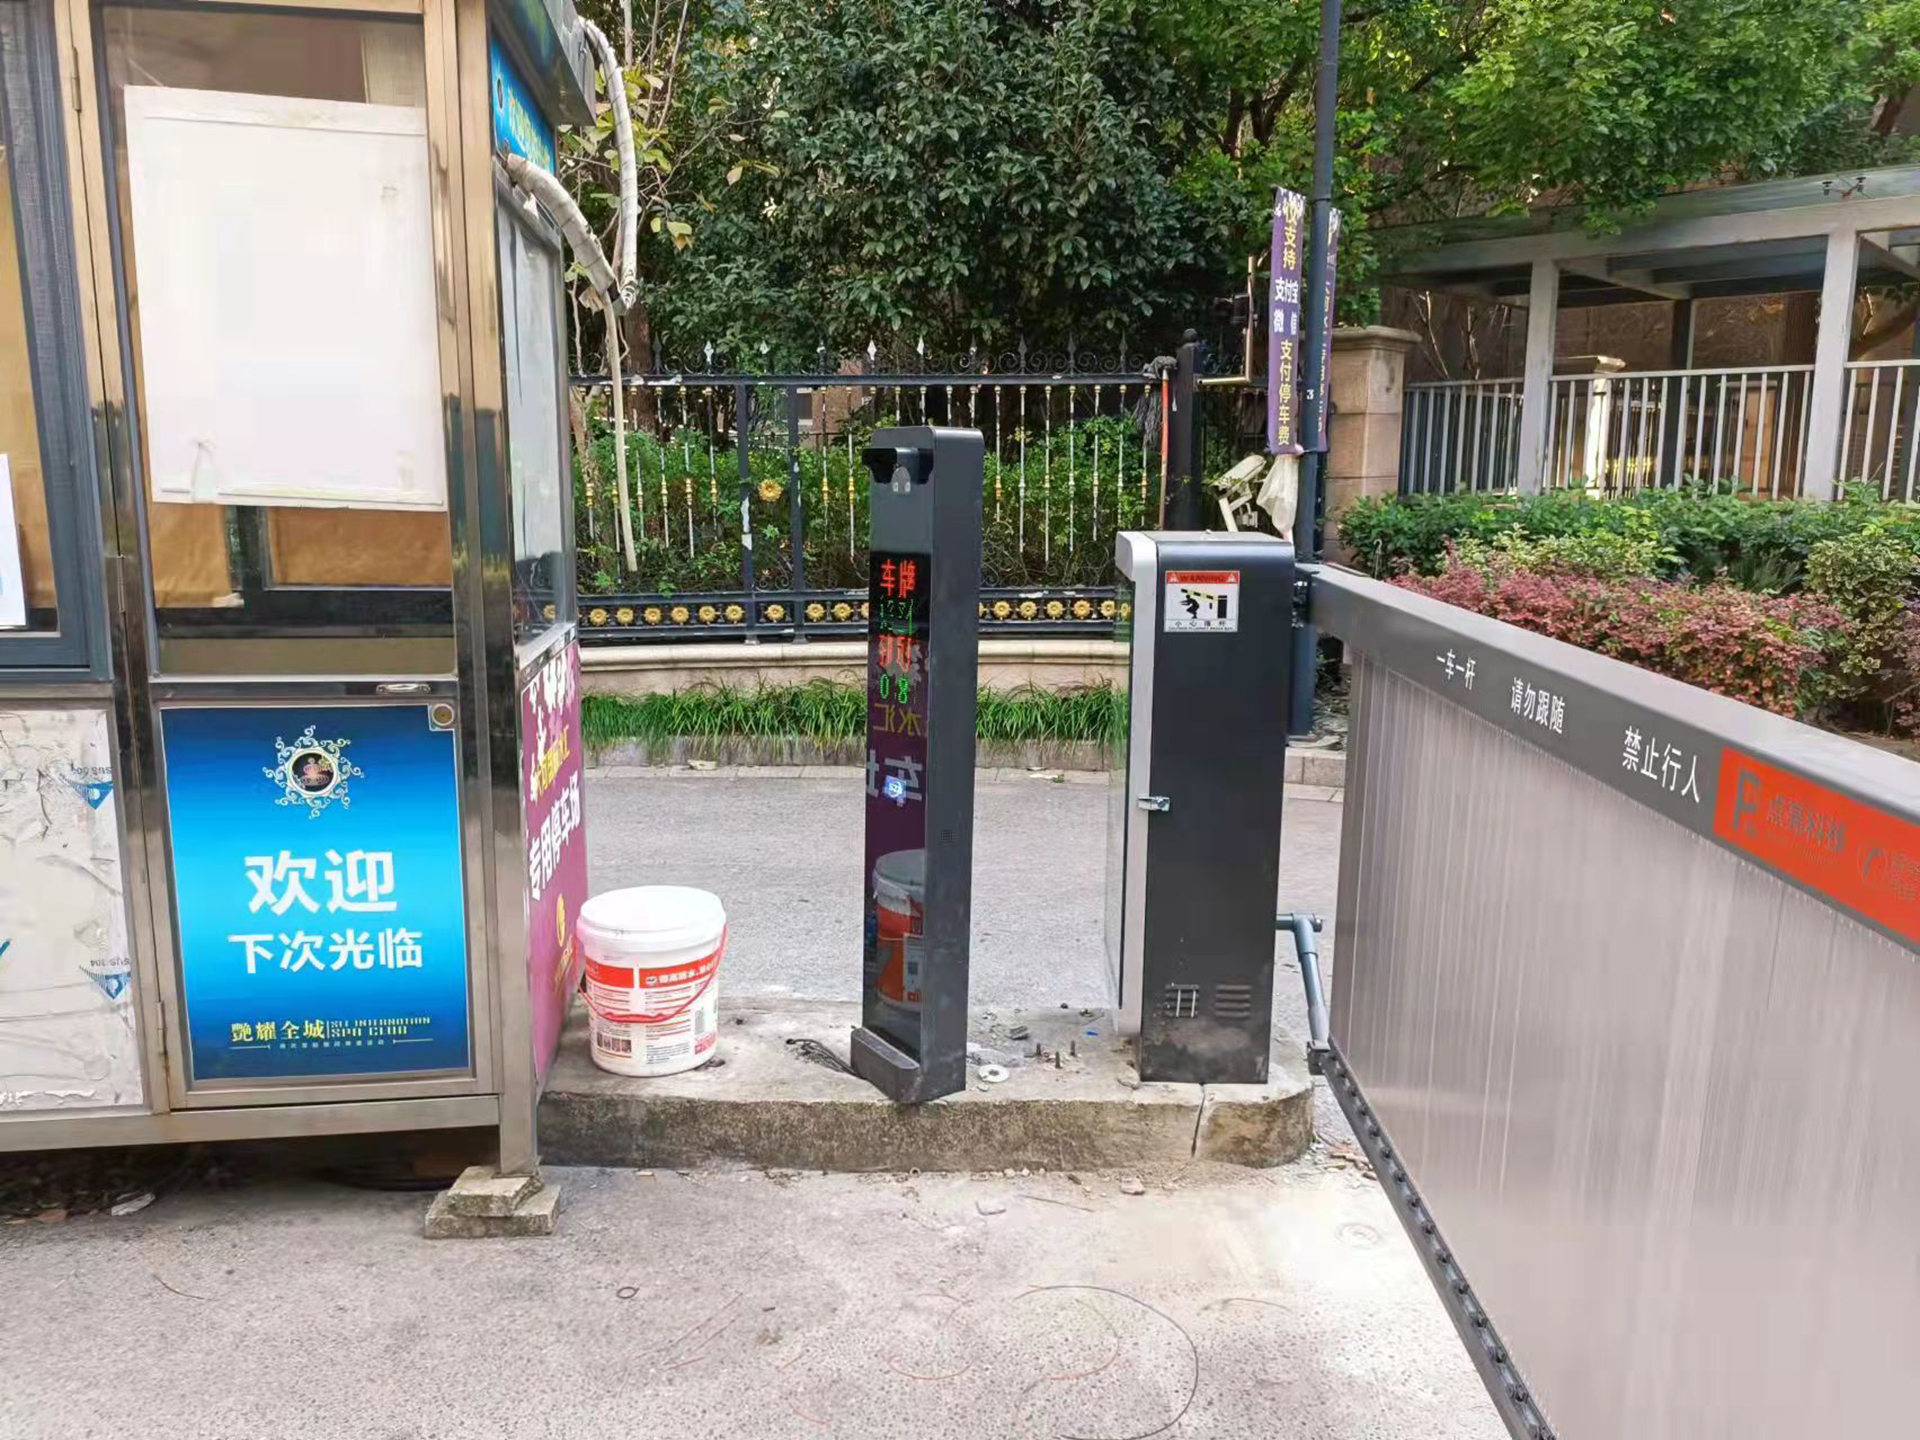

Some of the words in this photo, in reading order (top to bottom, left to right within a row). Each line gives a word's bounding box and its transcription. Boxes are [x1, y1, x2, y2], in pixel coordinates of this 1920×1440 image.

[1273, 308, 1298, 336] 微信
[1277, 340, 1293, 446] 支付停车费
[880, 560, 917, 598] 车牌
[1435, 648, 1477, 692] 一车一杆
[1510, 676, 1566, 735] 请勿跟随
[1621, 725, 1701, 804] 禁止行人
[529, 770, 581, 901] 专用停车场
[244, 849, 398, 917] 欢迎
[227, 927, 424, 975] 下次光临
